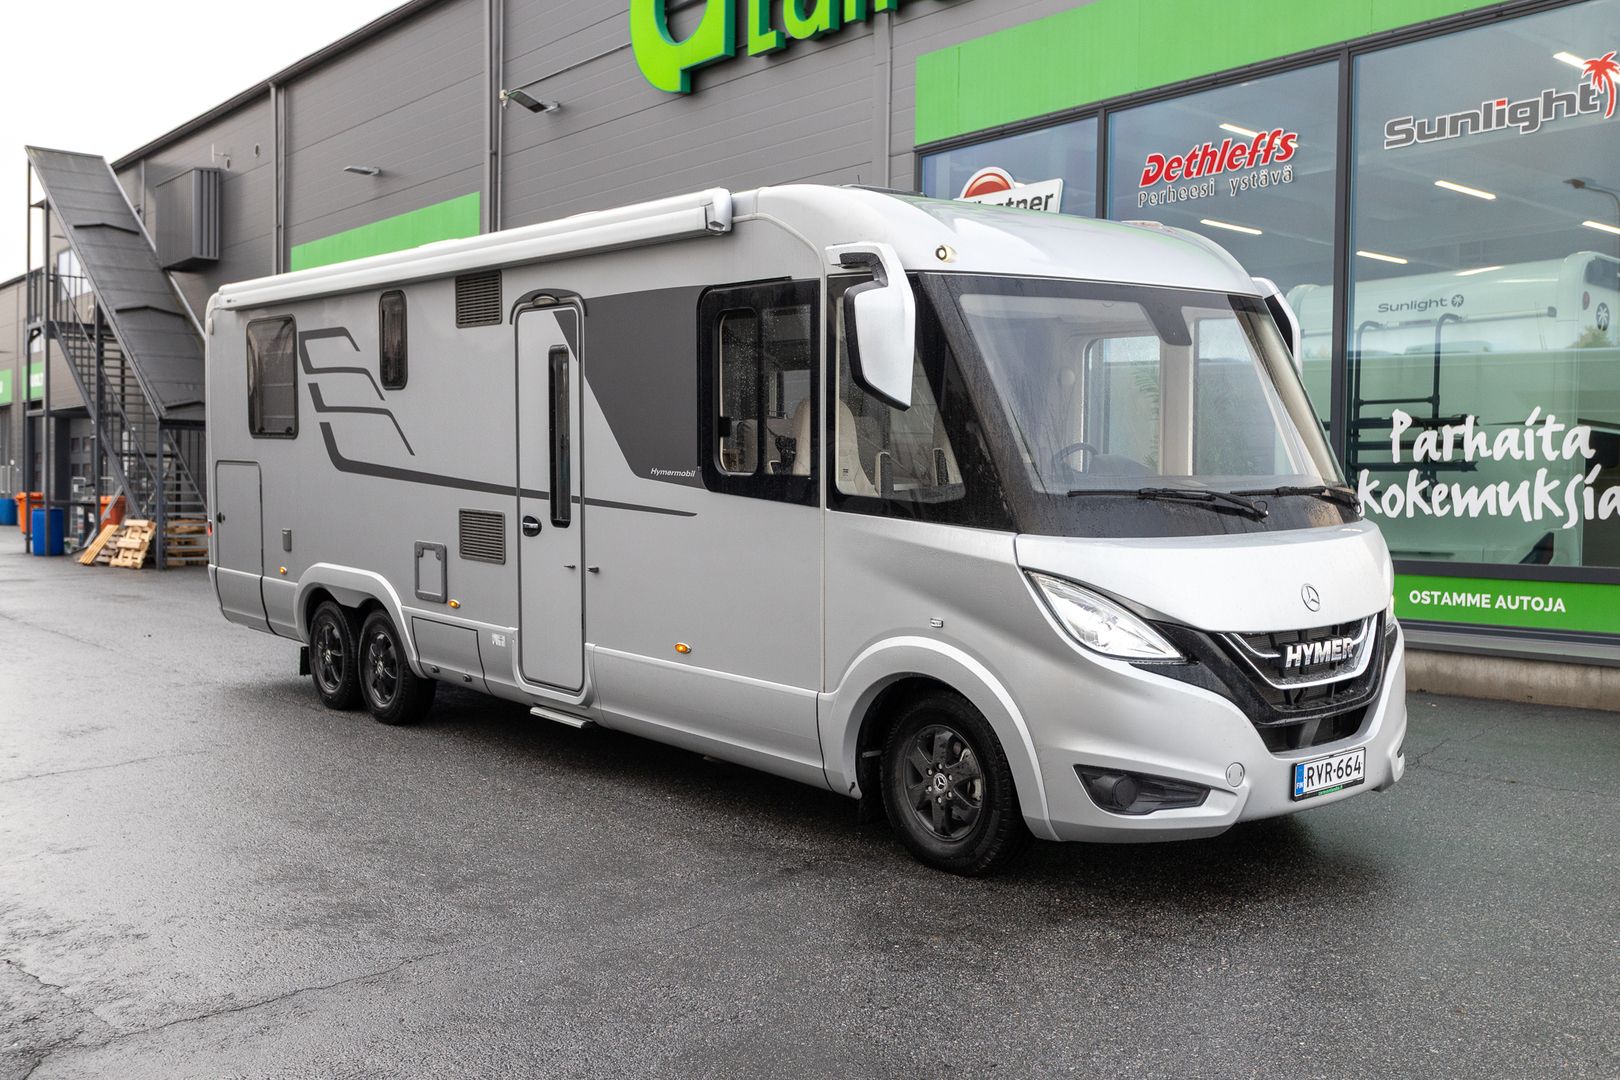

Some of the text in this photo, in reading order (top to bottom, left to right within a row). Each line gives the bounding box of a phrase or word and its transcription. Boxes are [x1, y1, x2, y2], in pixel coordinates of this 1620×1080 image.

[1384, 82, 1600, 149] Sunlight
[1139, 128, 1298, 187] Dethleffs
[1138, 164, 1293, 207] Perheesi ystävä
[650, 467, 696, 477] Hymermobil
[1409, 590, 1567, 613] OSTAMME AUTOJA
[1284, 637, 1354, 668] HYMER
[1306, 755, 1362, 788] RVR-664
